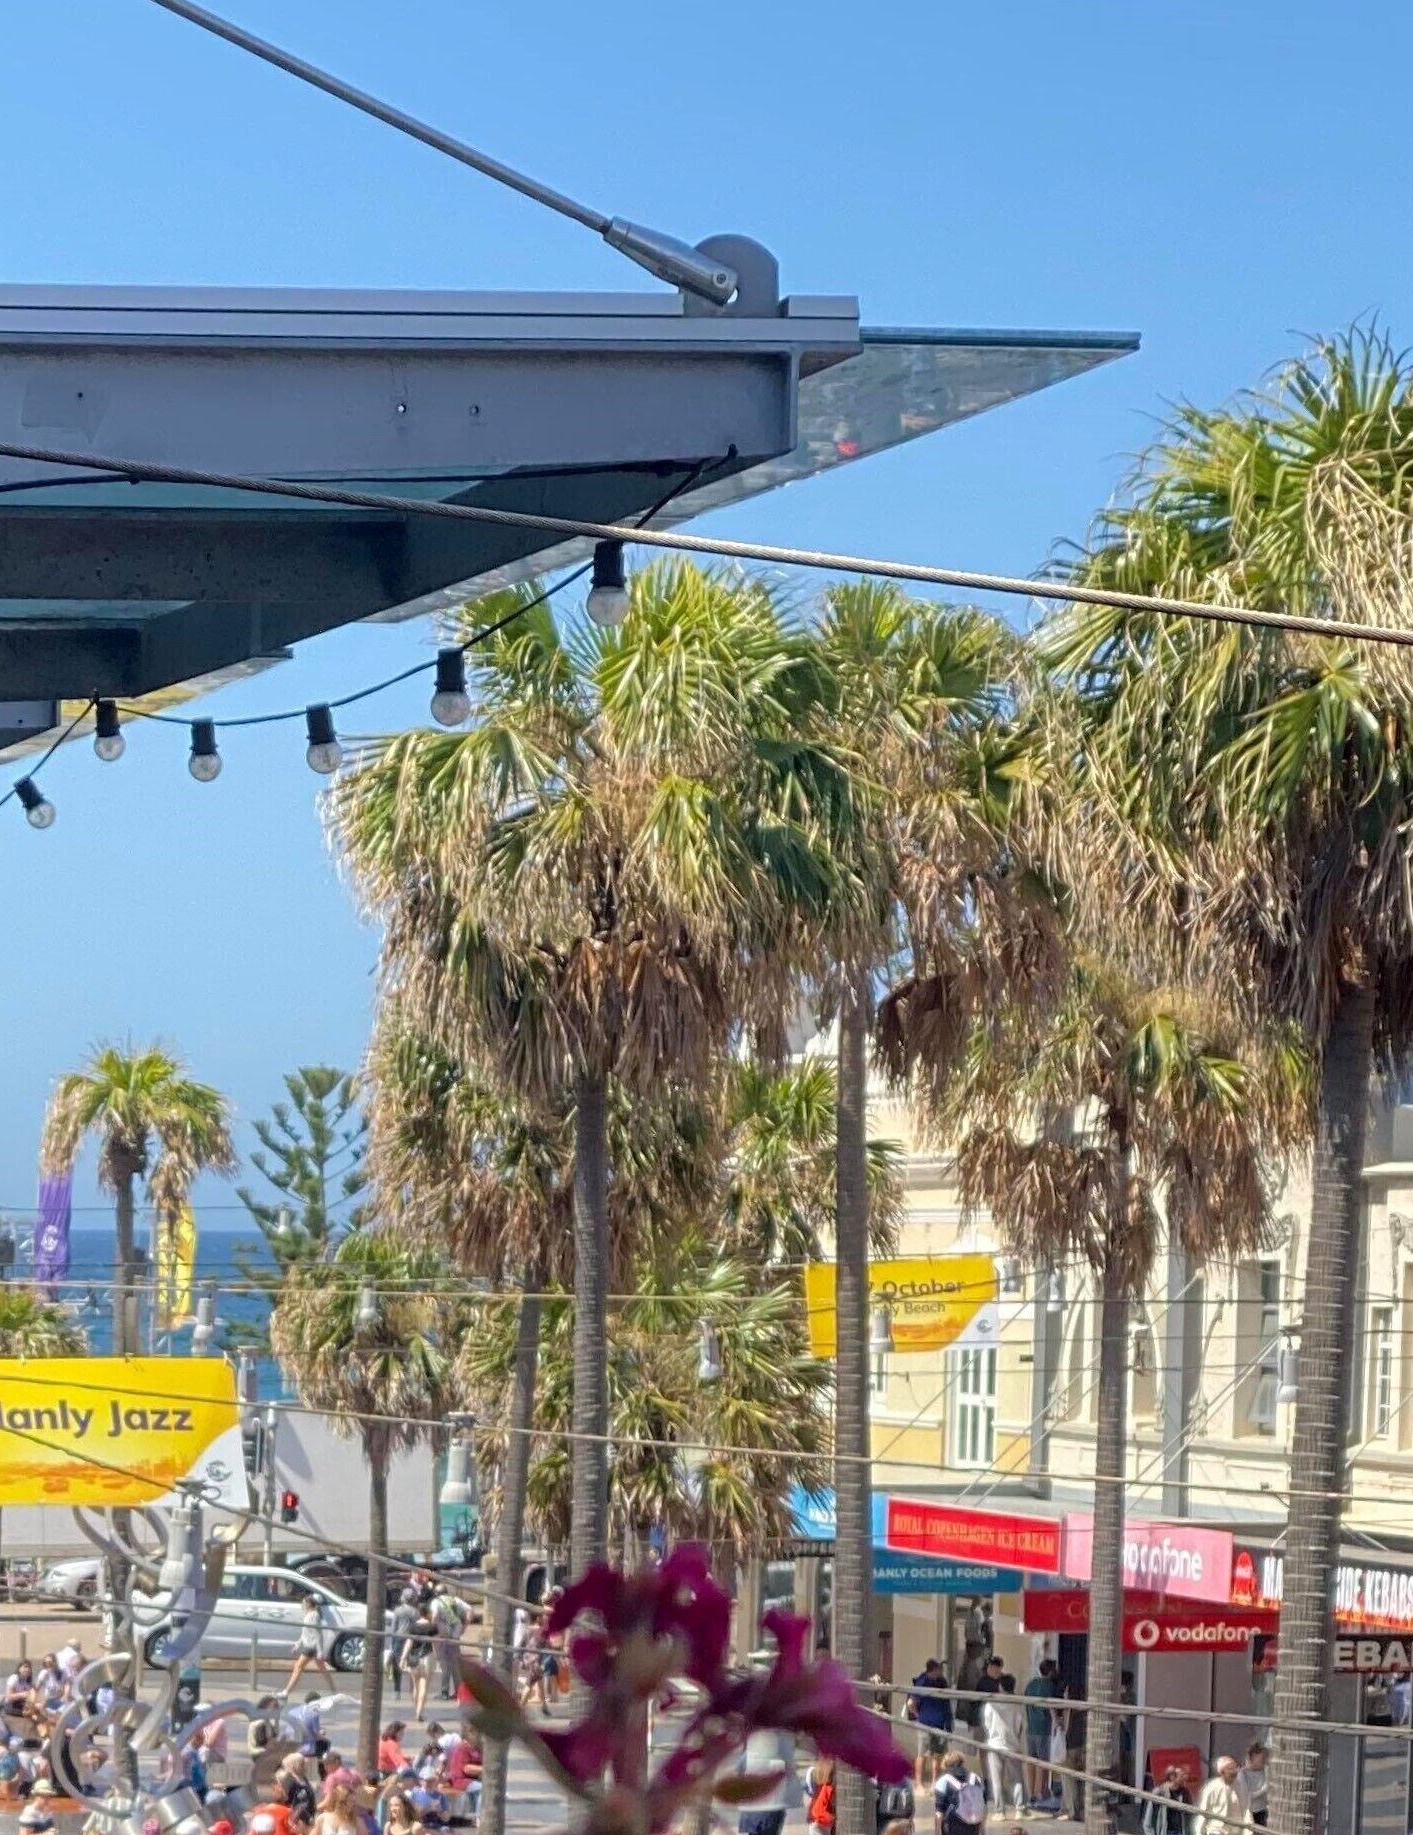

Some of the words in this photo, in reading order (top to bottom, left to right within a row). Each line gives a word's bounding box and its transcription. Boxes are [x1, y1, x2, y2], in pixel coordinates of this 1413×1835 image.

[882, 1279, 964, 1297] October
[904, 1302, 946, 1314] Beach
[108, 1400, 194, 1437] Jazz
[893, 1513, 923, 1535] ROYAL
[927, 1518, 995, 1545] COPENHAGEN
[997, 1529, 1015, 1550] ICE
[1017, 1531, 1055, 1555] CREAM
[910, 1567, 952, 1579] OCEAN
[956, 1567, 998, 1579] FOODS
[1334, 1639, 1413, 1671] EBA
